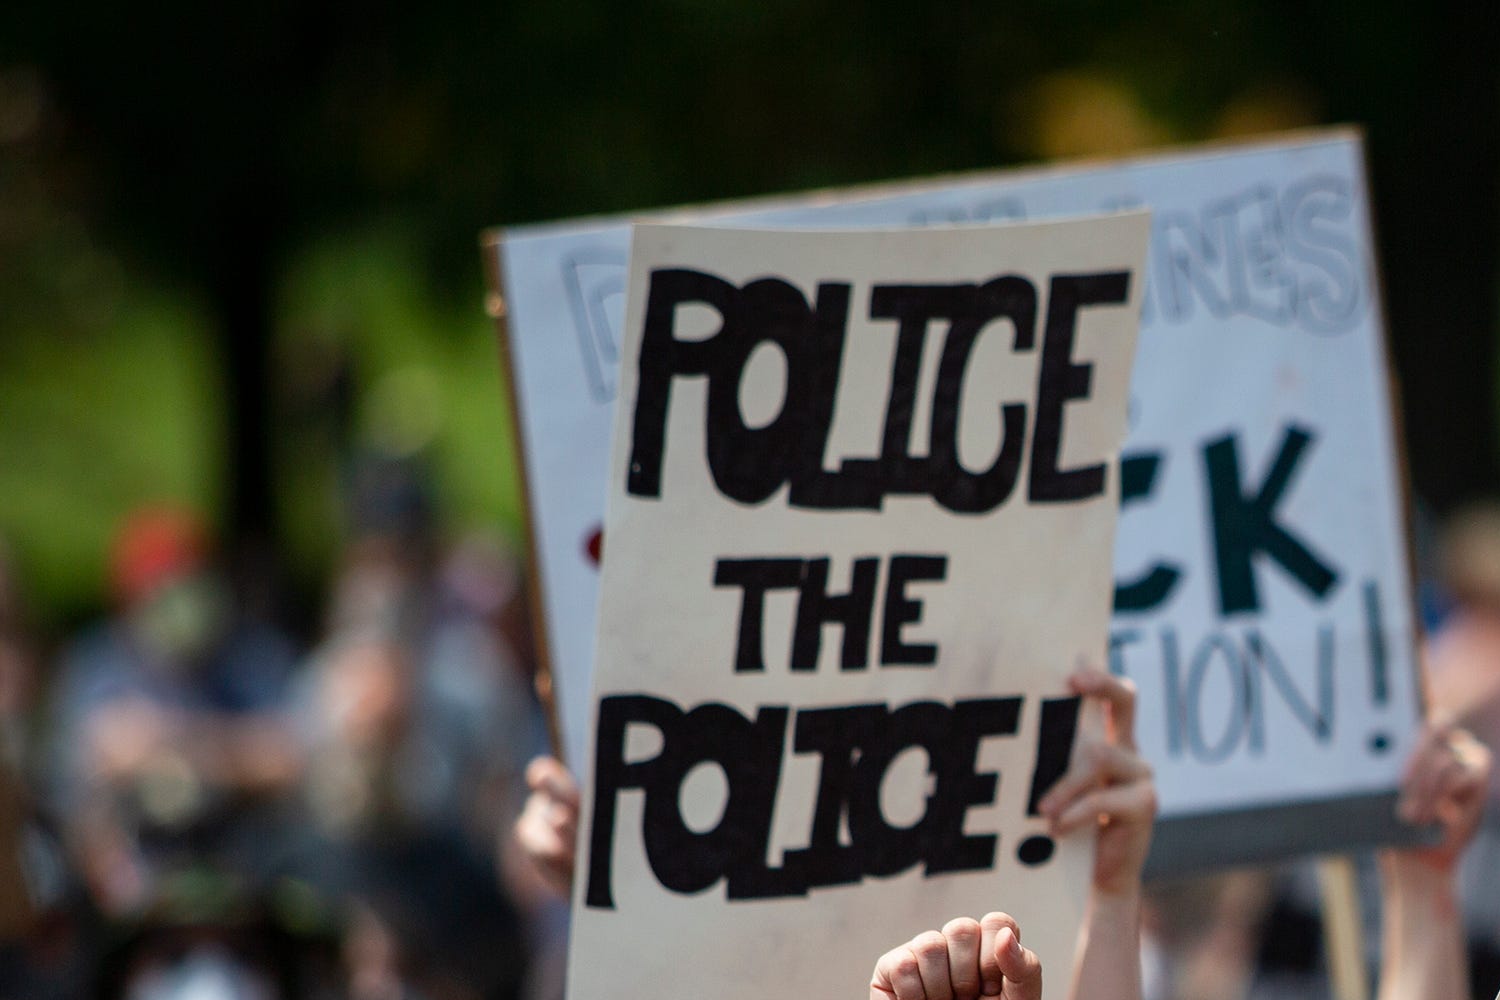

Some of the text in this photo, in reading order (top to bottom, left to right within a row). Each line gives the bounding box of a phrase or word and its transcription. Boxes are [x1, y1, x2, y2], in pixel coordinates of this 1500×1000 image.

[626, 267, 1134, 516] POLICE
[712, 554, 949, 673] THE
[1110, 422, 1342, 616] CK
